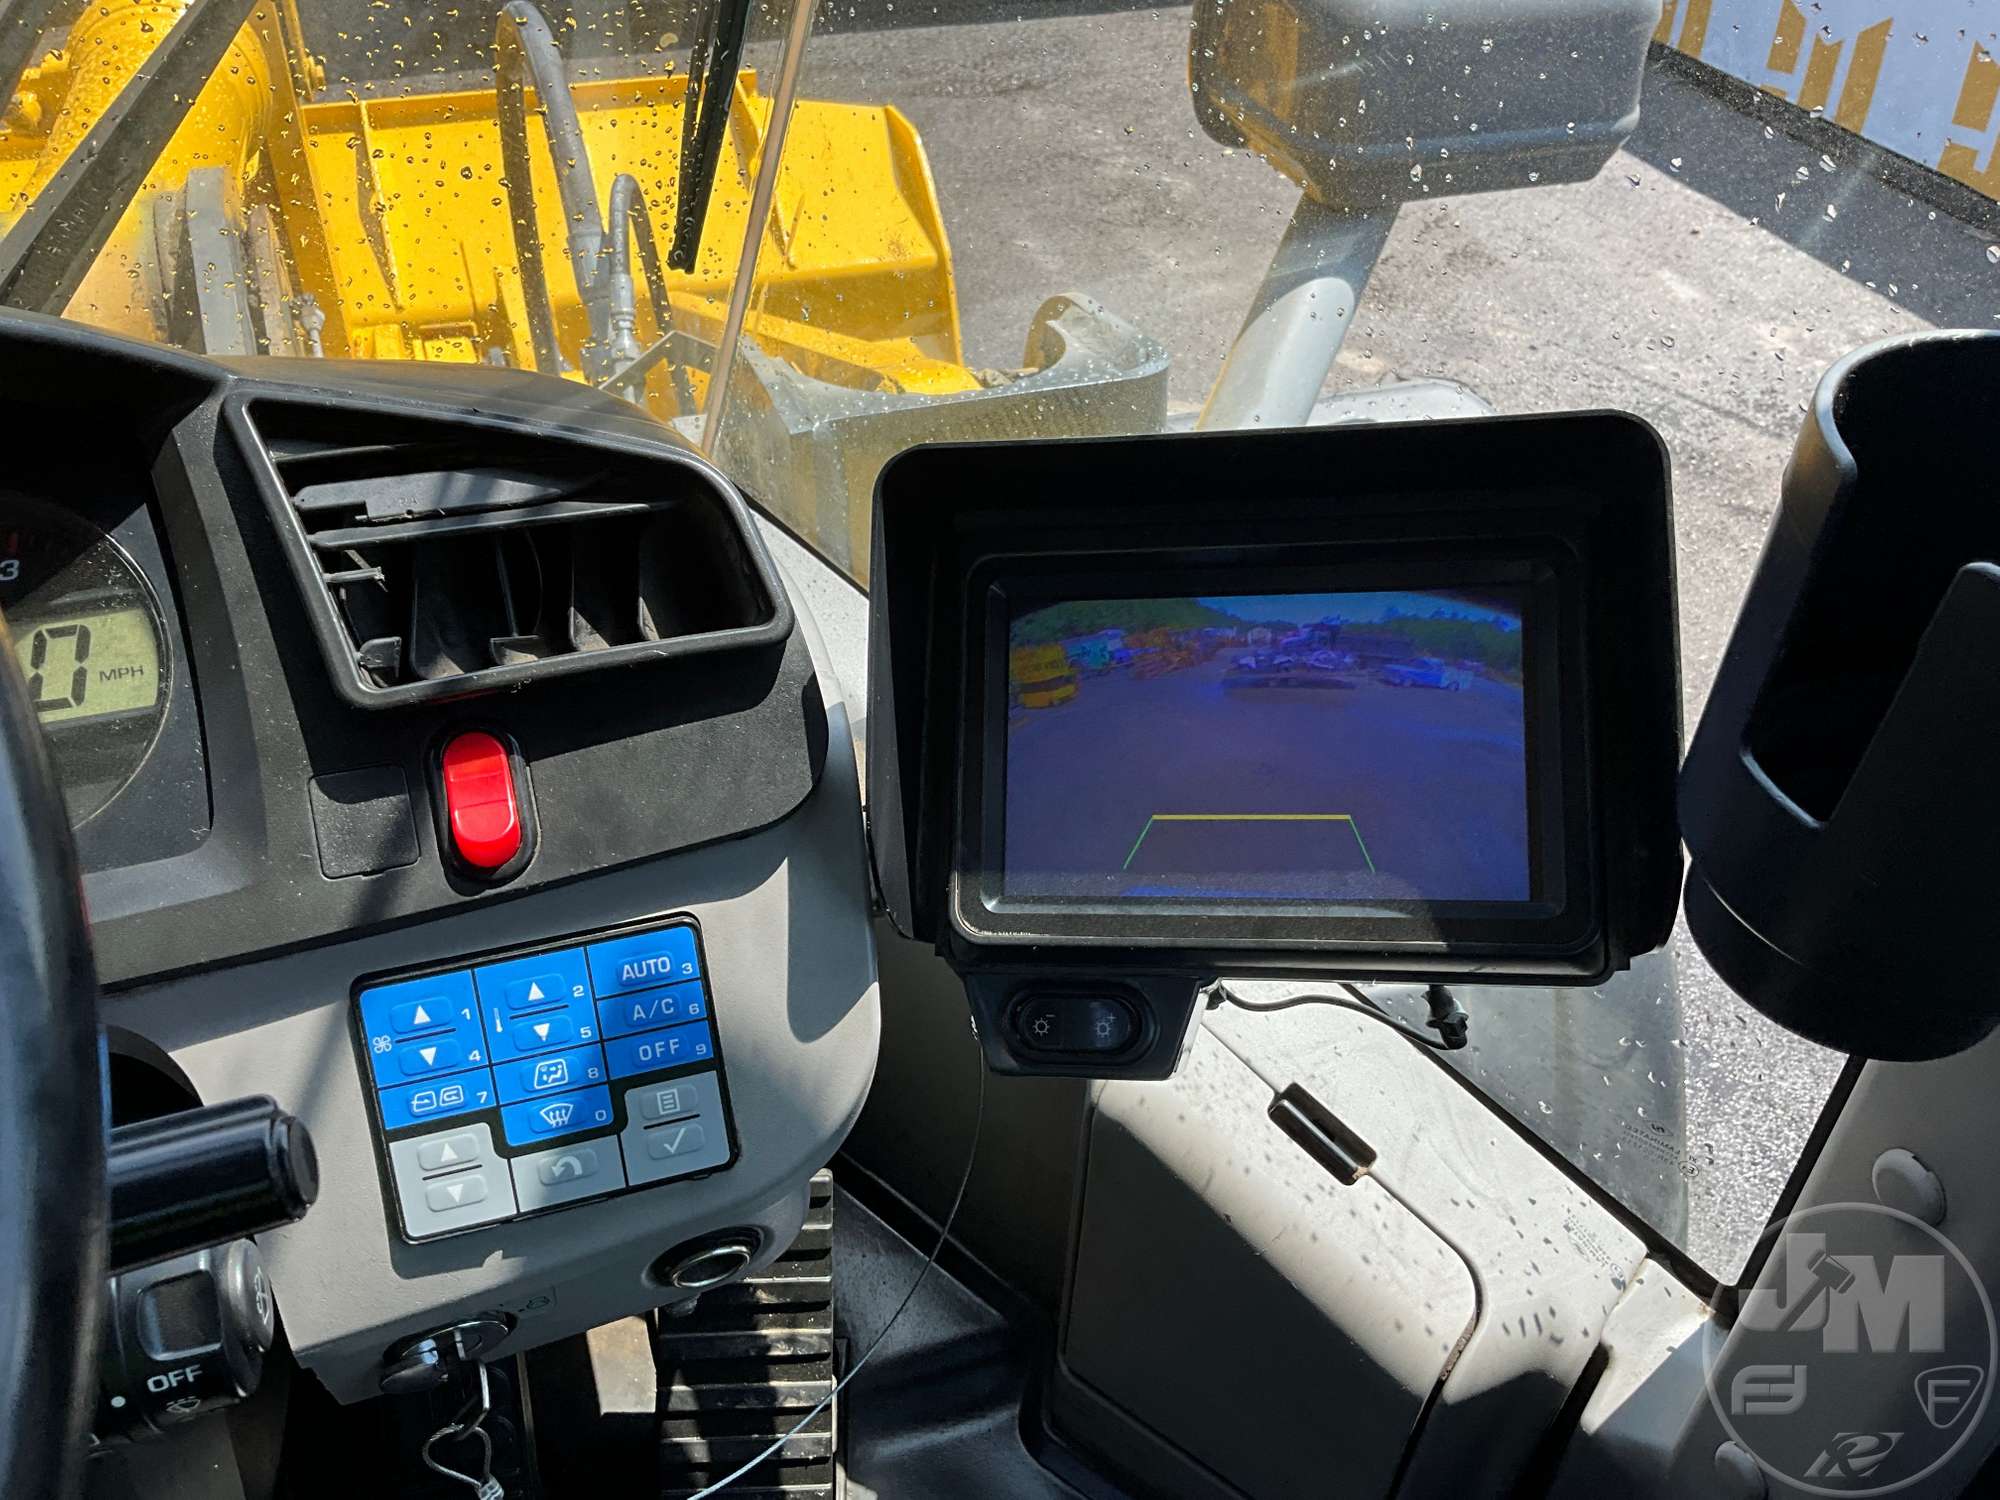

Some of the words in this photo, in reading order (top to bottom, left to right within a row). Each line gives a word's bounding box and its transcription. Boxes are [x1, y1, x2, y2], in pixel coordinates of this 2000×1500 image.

[0, 559, 20, 581] 3
[29, 624, 91, 713] 0
[99, 666, 145, 682] MPH
[623, 957, 670, 980] AUTO
[682, 963, 692, 974] 3
[573, 985, 584, 997] 2
[462, 1008, 471, 1020] 1
[634, 999, 673, 1020] A/C
[689, 1004, 699, 1014] 6
[581, 1027, 591, 1038] 5
[640, 1039, 679, 1060] OFF
[696, 1044, 706, 1054] 9
[469, 1050, 481, 1061] 4
[588, 1068, 598, 1078] 8
[477, 1091, 487, 1103] 7
[147, 1364, 203, 1392] OFF
